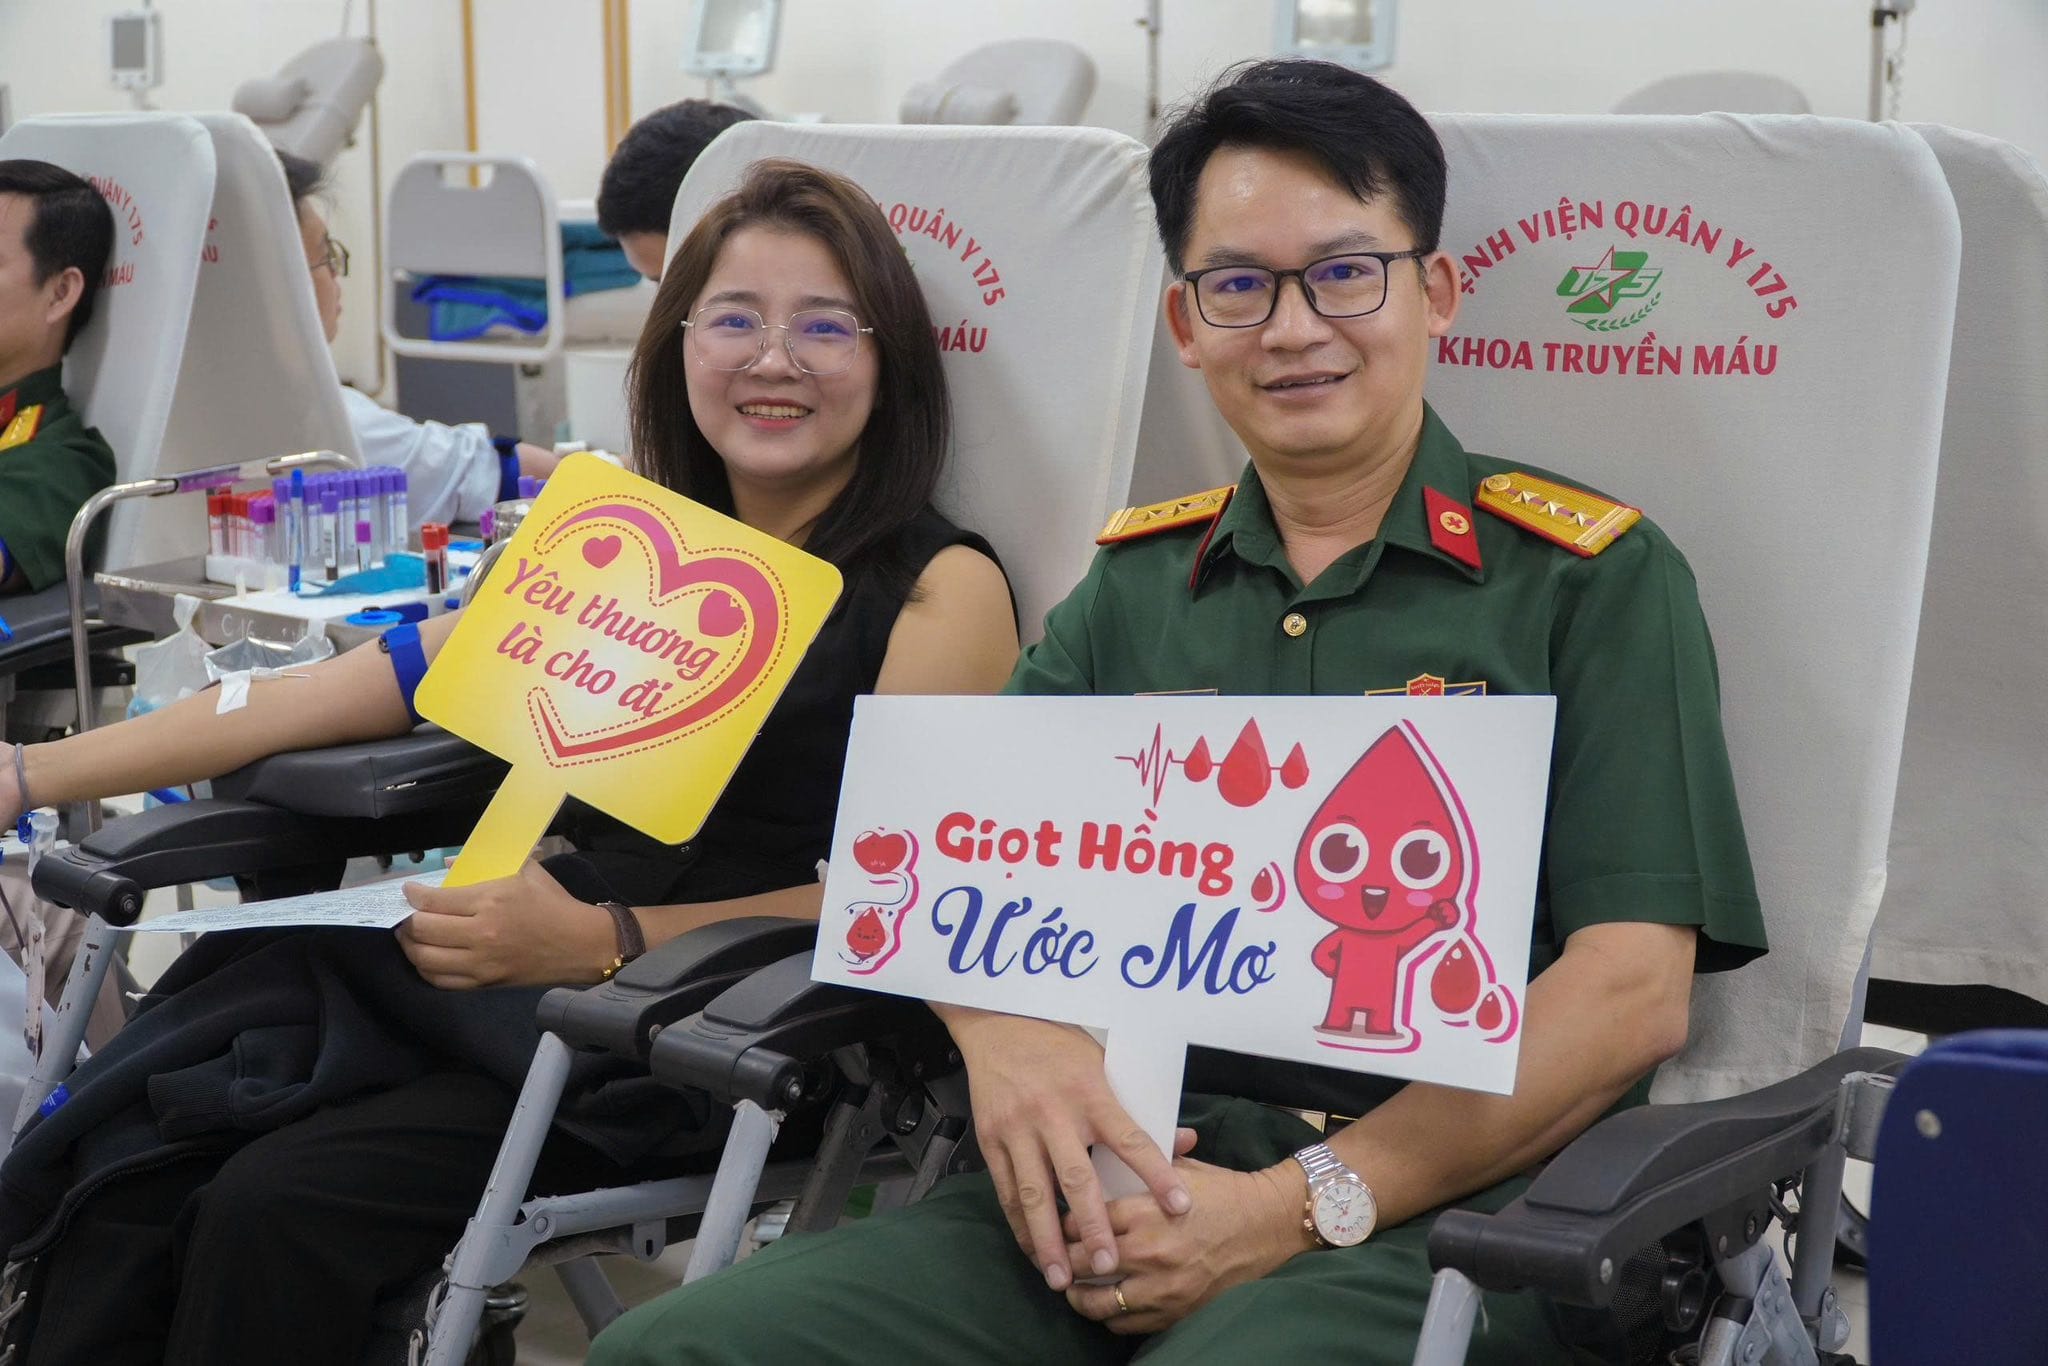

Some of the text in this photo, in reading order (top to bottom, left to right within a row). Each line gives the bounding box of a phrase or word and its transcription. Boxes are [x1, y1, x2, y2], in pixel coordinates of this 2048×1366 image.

[122, 191, 132, 211] Y
[129, 206, 143, 245] 175
[889, 203, 1005, 306] QUÂN Y 175
[1518, 196, 1604, 242] VIỆN
[1614, 200, 1723, 255] QUÂN
[1726, 237, 1755, 270] Y
[1746, 261, 1798, 319] 175
[931, 319, 988, 353] MÁU
[1438, 331, 1778, 376] KHOA TRUYỀN MÁU
[503, 558, 720, 681] Yêu thương
[496, 621, 673, 717] là cho đi
[935, 808, 1235, 898] Giọt Hồng
[931, 885, 1277, 995] Ước Mơ
